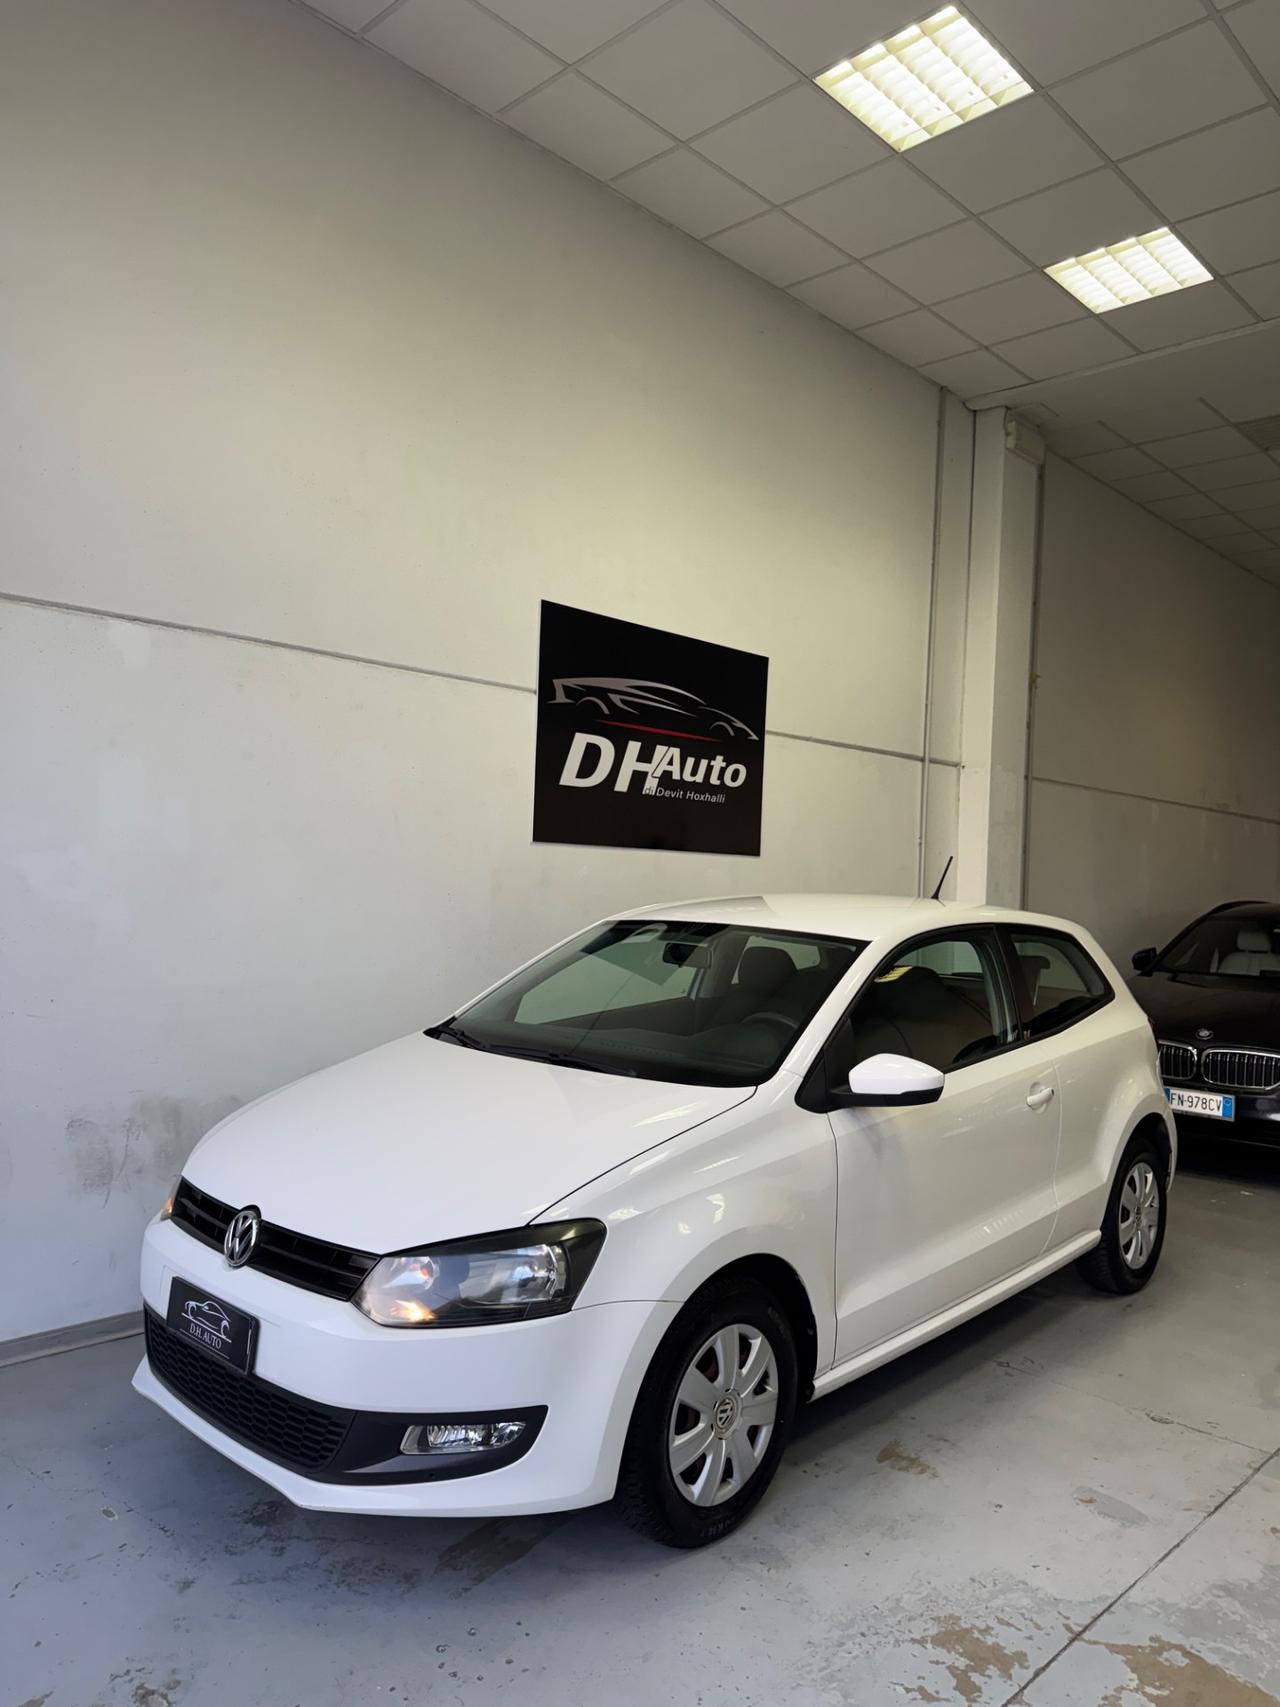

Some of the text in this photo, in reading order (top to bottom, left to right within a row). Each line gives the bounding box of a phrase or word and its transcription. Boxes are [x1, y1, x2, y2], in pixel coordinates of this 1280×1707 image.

[656, 787, 684, 799] Devit
[686, 790, 726, 804] Hoxhalli
[202, 1331, 222, 1349] AUTO
